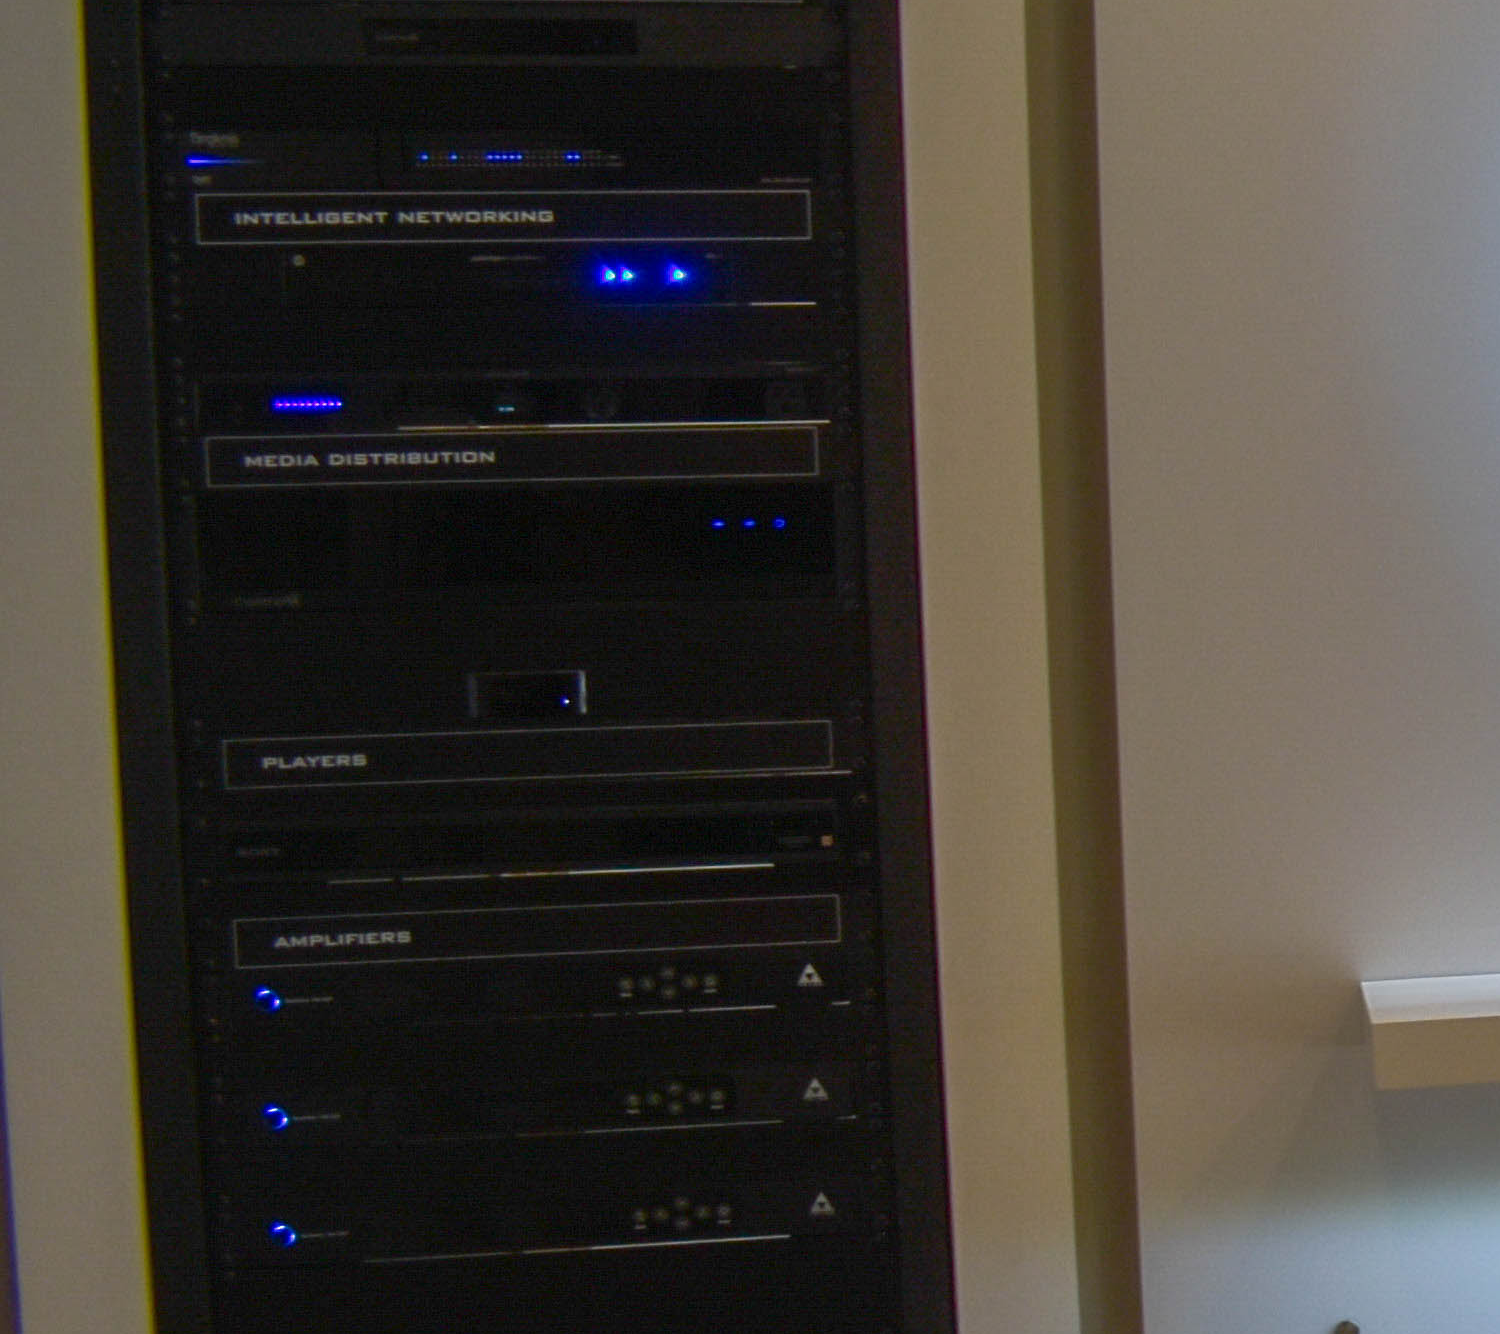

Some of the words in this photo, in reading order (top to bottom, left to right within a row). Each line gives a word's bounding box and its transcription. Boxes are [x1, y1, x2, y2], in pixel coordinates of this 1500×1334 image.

[233, 210, 389, 226] INTELLIGENT
[397, 208, 555, 224] NETWORKING
[242, 453, 321, 468] MEDIA
[327, 450, 497, 466] DISTRIBUTION
[261, 753, 369, 769] PLAYERS
[273, 930, 413, 948] AMPLIFIERS
